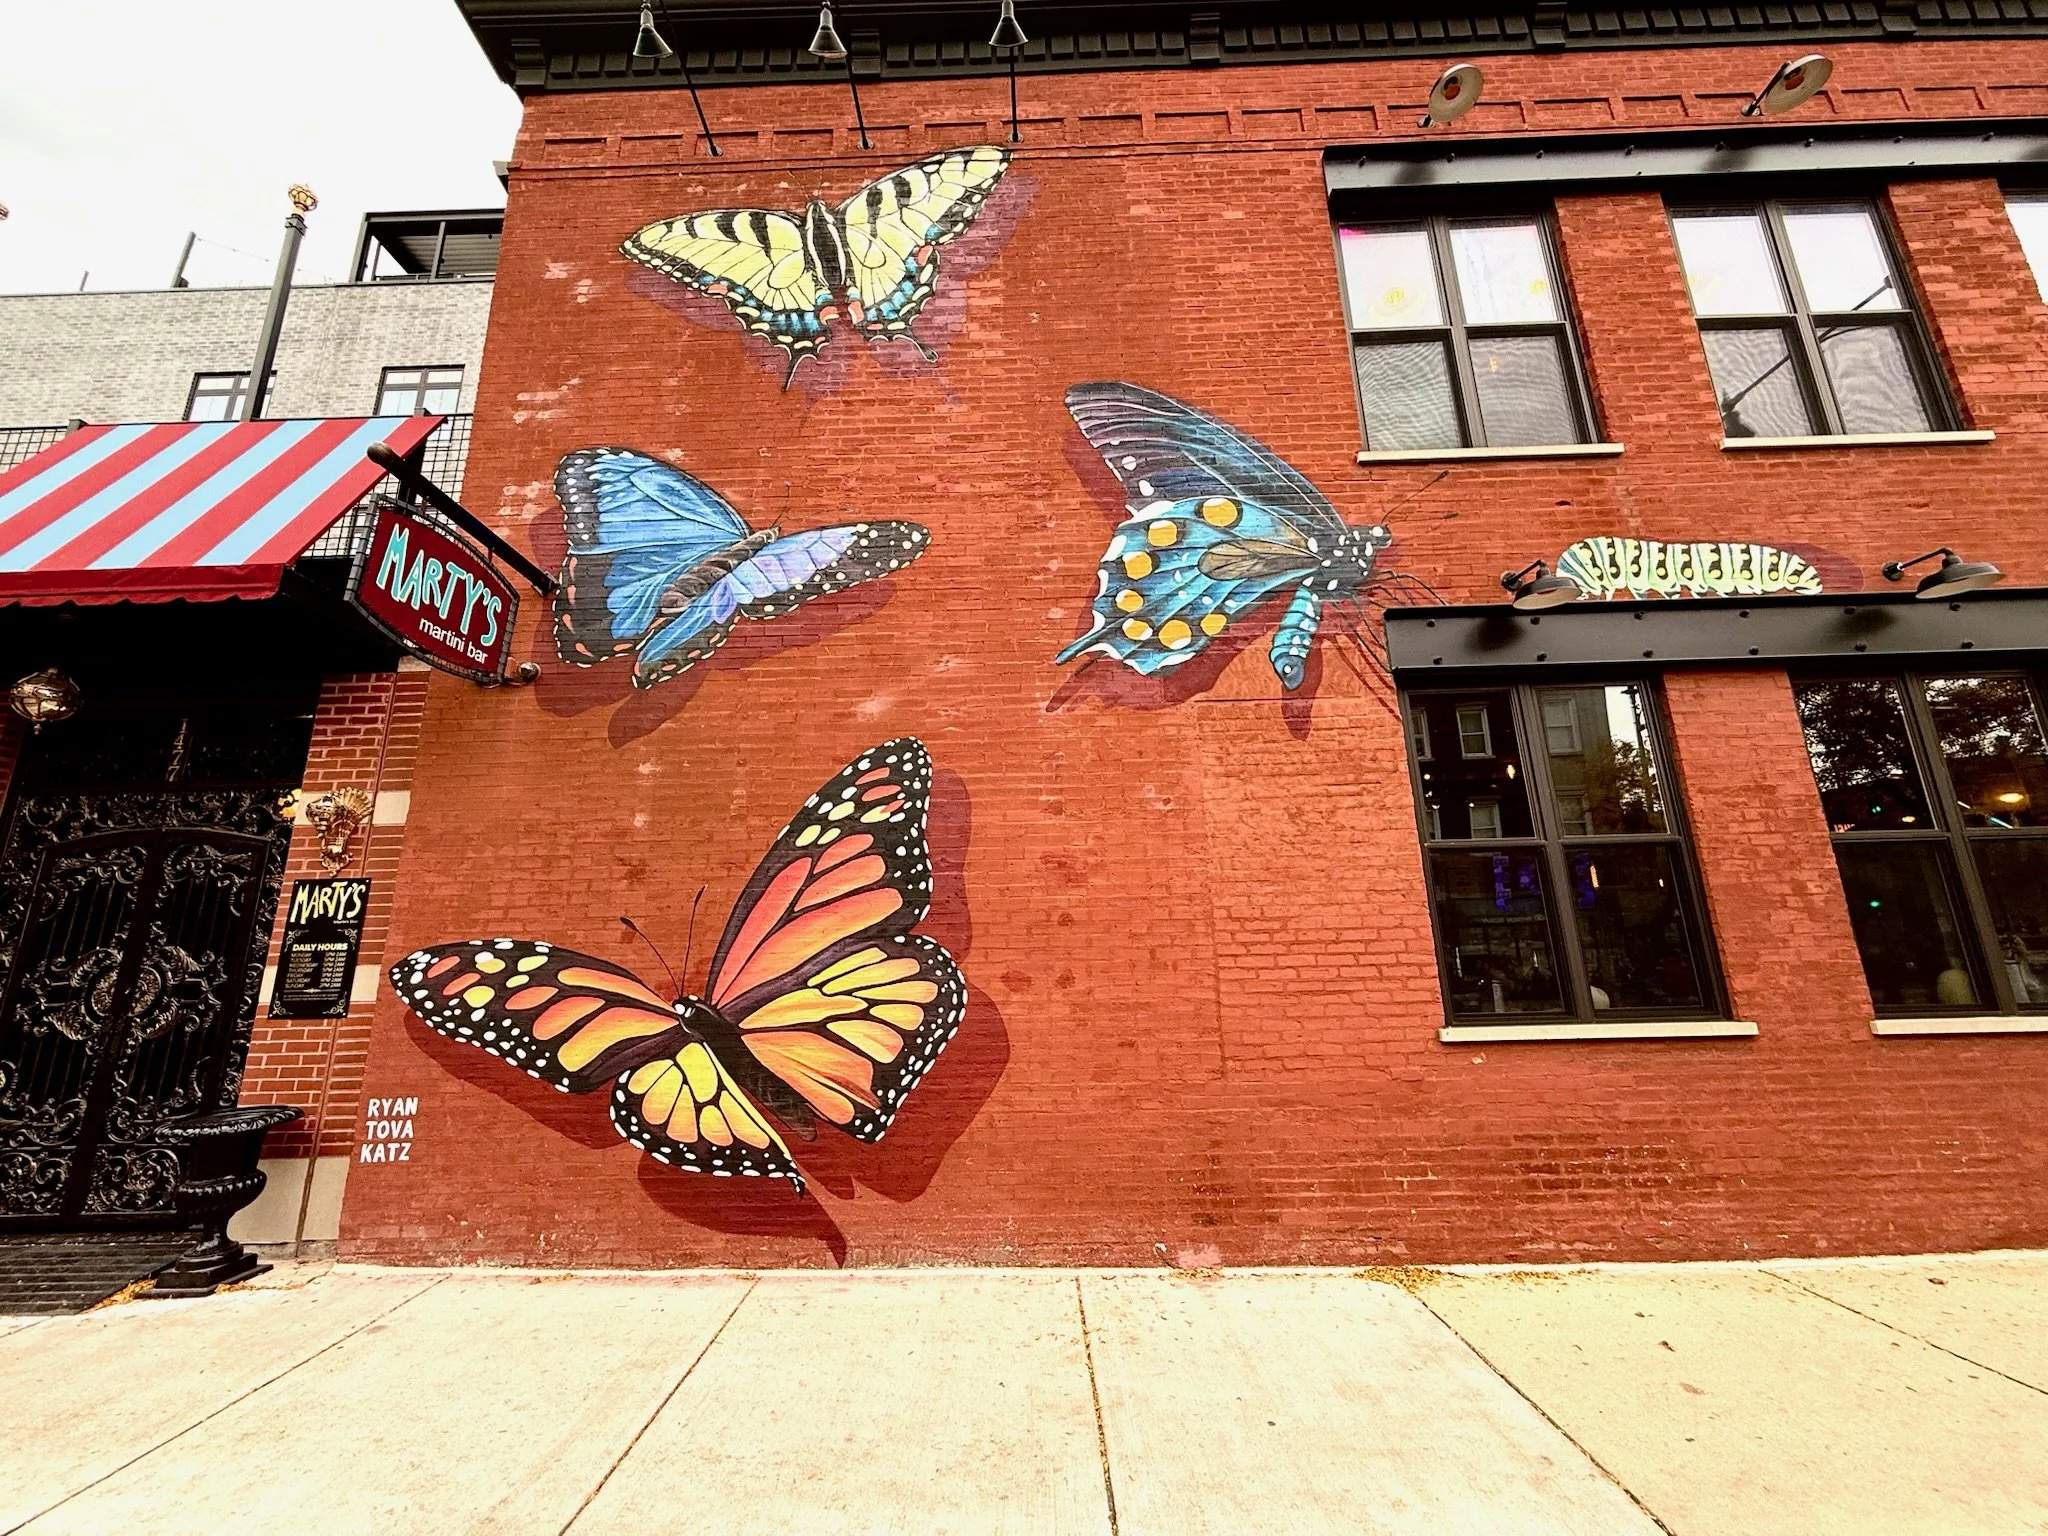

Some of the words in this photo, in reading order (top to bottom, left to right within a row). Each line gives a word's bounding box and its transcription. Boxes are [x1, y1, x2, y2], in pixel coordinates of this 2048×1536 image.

[376, 523, 502, 647] MARTY'S
[419, 618, 465, 653] martini
[467, 641, 488, 664] bar
[167, 718, 188, 782] 1477
[289, 881, 366, 925] MARTY'S
[292, 943, 317, 952] DAILY
[317, 942, 348, 951] HOURS
[367, 1096, 419, 1118] RYAN
[365, 1119, 414, 1140] TOVA
[360, 1142, 412, 1163] KATZ
